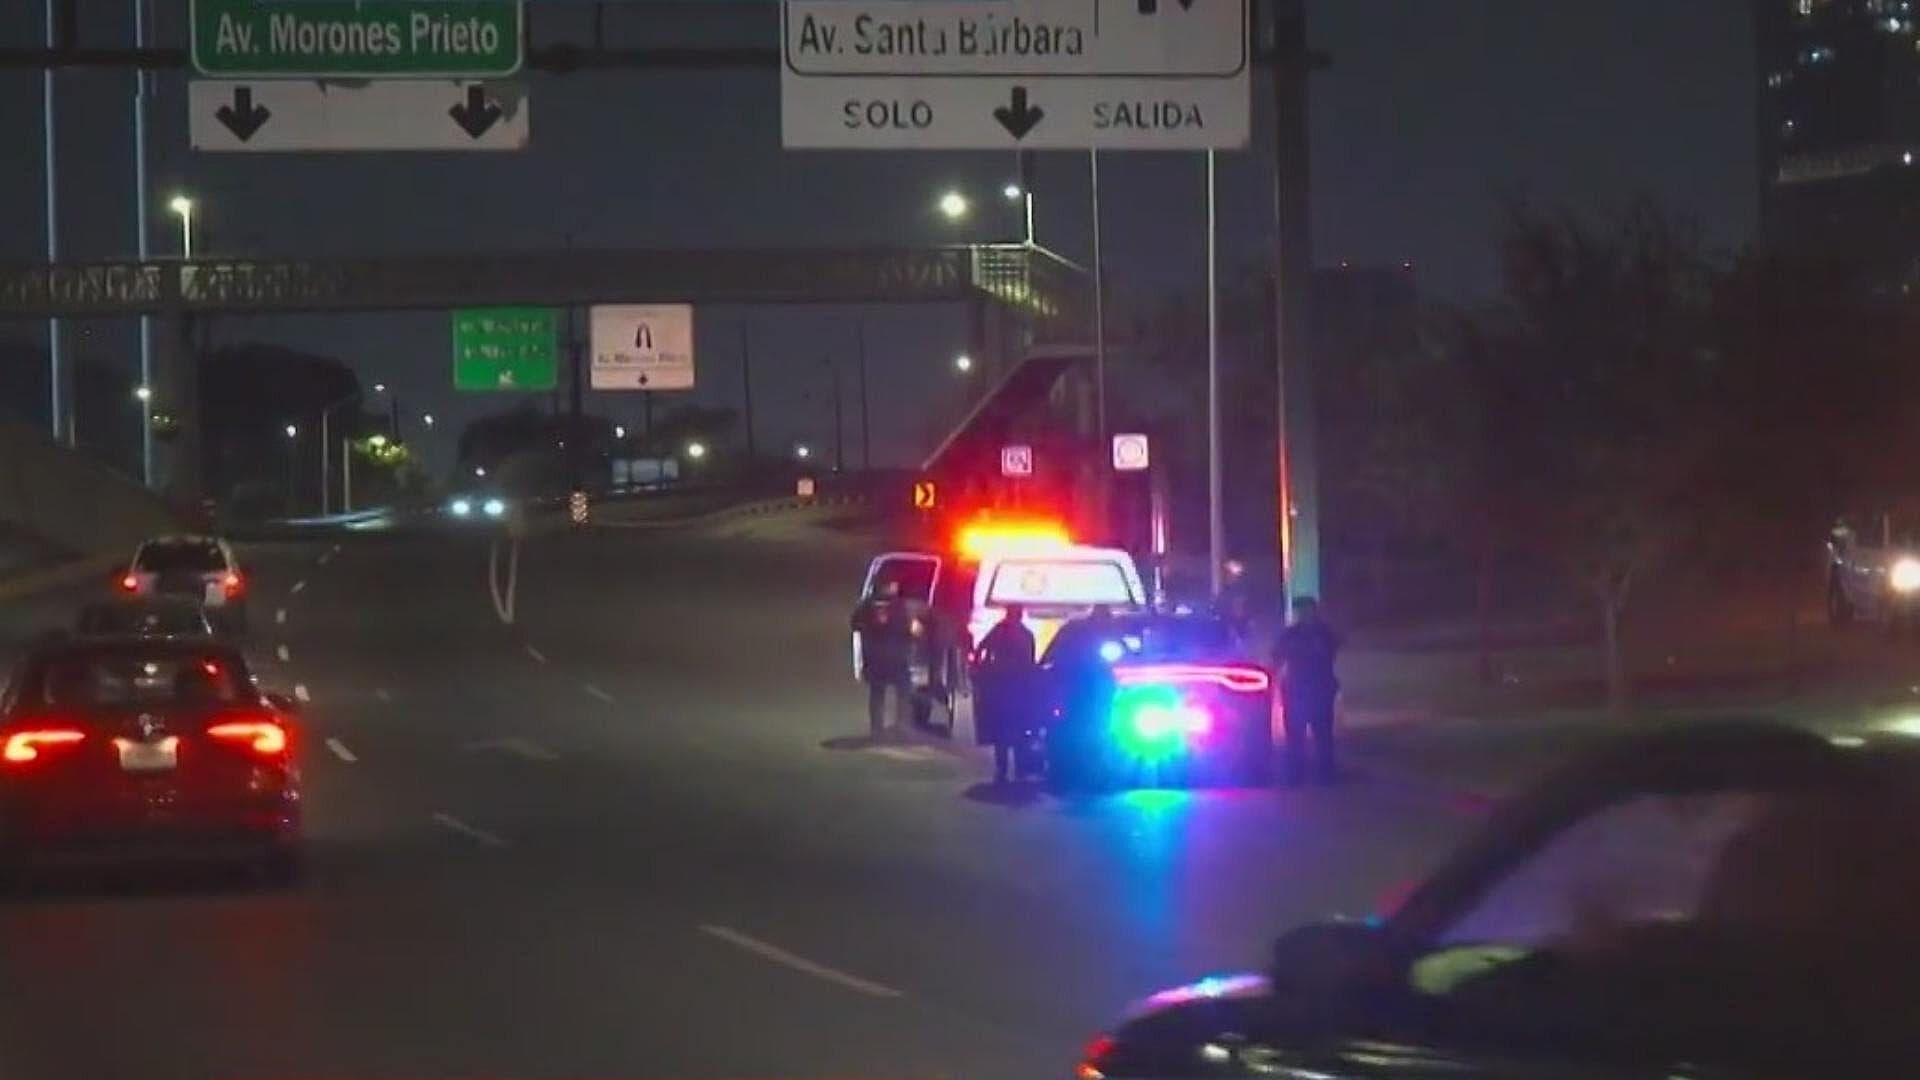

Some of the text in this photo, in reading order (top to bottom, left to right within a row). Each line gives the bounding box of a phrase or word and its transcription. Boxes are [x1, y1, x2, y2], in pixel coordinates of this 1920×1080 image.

[216, 12, 499, 54] Av. Morones Prieto
[800, 15, 843, 55] Av.
[844, 100, 933, 129] SOLO
[1094, 101, 1203, 129] SALIDA
